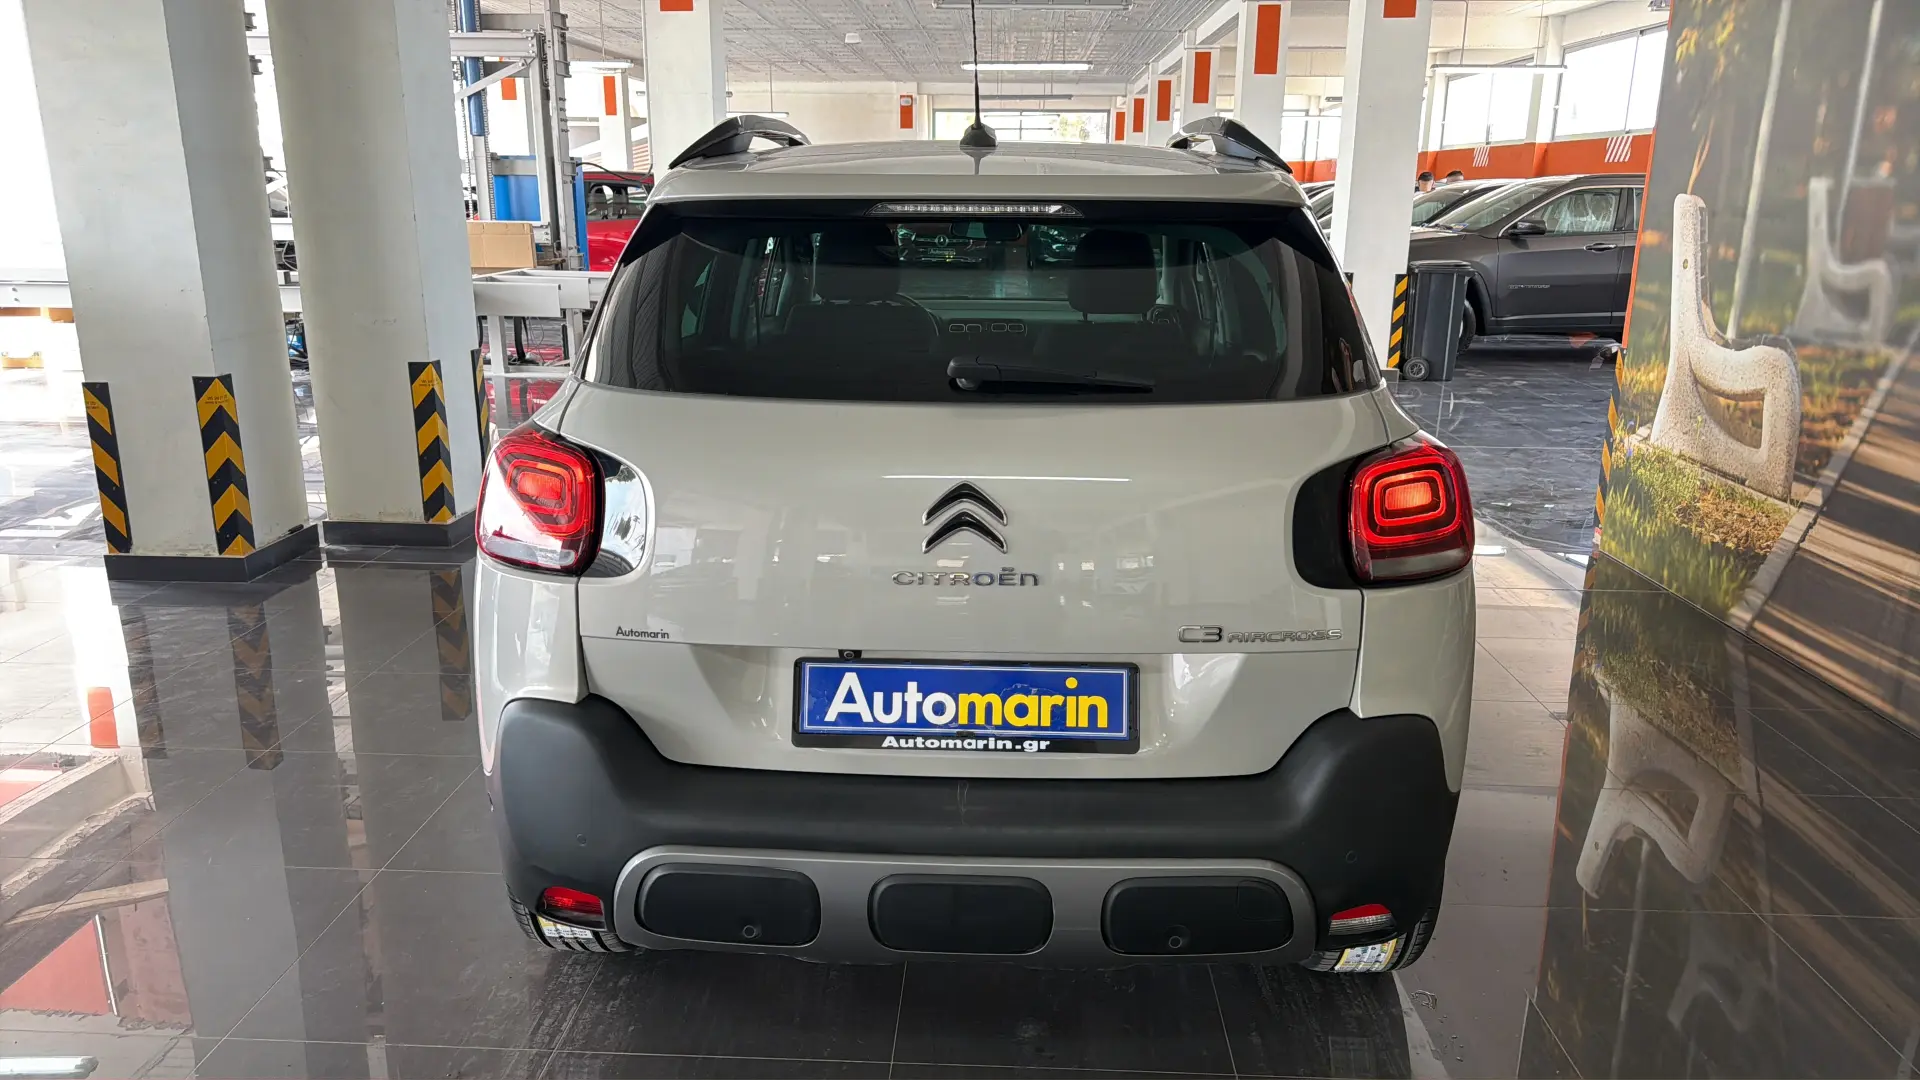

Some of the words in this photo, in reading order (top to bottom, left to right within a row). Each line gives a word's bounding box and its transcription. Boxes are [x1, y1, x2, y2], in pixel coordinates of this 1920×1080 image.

[616, 625, 670, 639] Automarin
[1178, 625, 1223, 643] C3
[1227, 628, 1343, 643] AIRCROSS
[824, 672, 1108, 728] Automarin
[881, 735, 1050, 752] Automarin.gr
